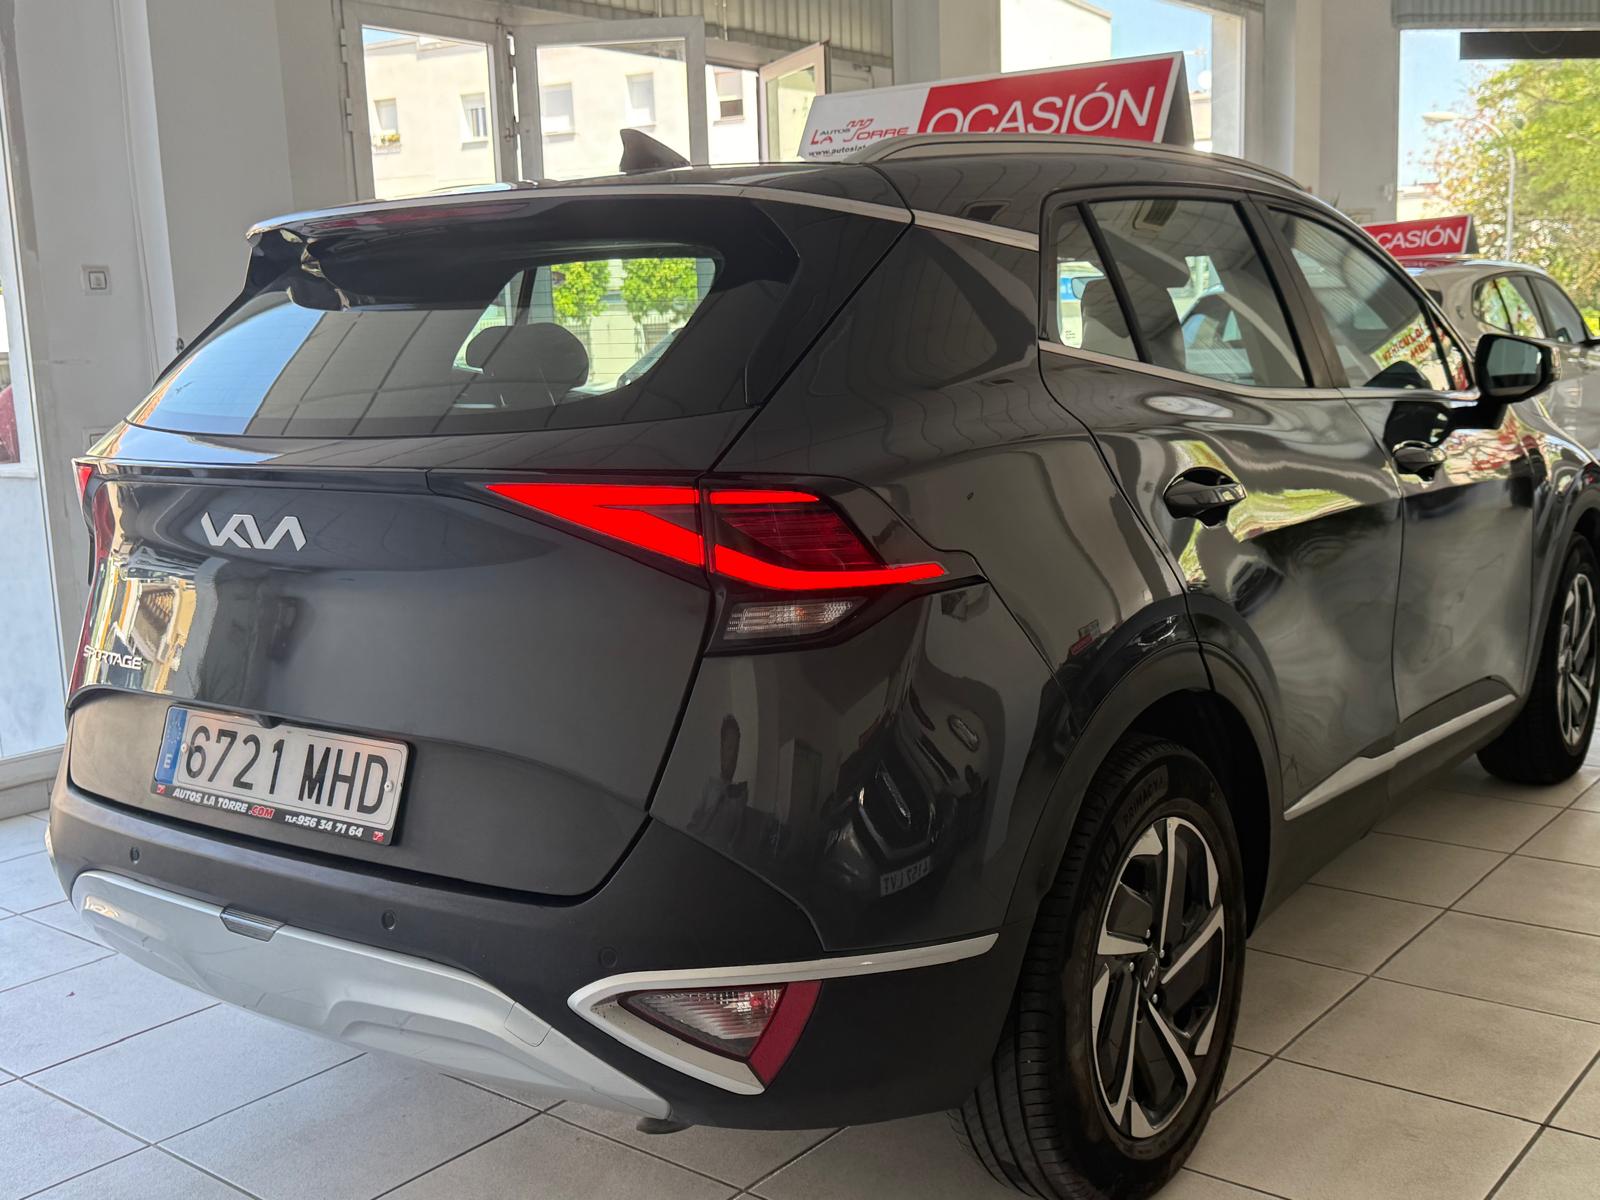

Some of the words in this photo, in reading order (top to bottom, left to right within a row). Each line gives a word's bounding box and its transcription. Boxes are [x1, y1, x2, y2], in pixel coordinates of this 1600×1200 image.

[926, 82, 1156, 134] OCASIÓN
[811, 129, 833, 145] LA
[820, 128, 851, 136] AUTOS
[1373, 224, 1463, 250] CASIÓN
[200, 511, 307, 552] KIA
[83, 645, 143, 670] SPORTAGE
[163, 753, 172, 769] E
[185, 725, 285, 795] 6721
[298, 743, 390, 815] MHD
[173, 788, 203, 802] AUTOS
[203, 795, 216, 806] LA
[218, 797, 249, 812] TORRE
[318, 820, 333, 831] 34
[334, 822, 348, 834] 71
[348, 825, 364, 837] 64
